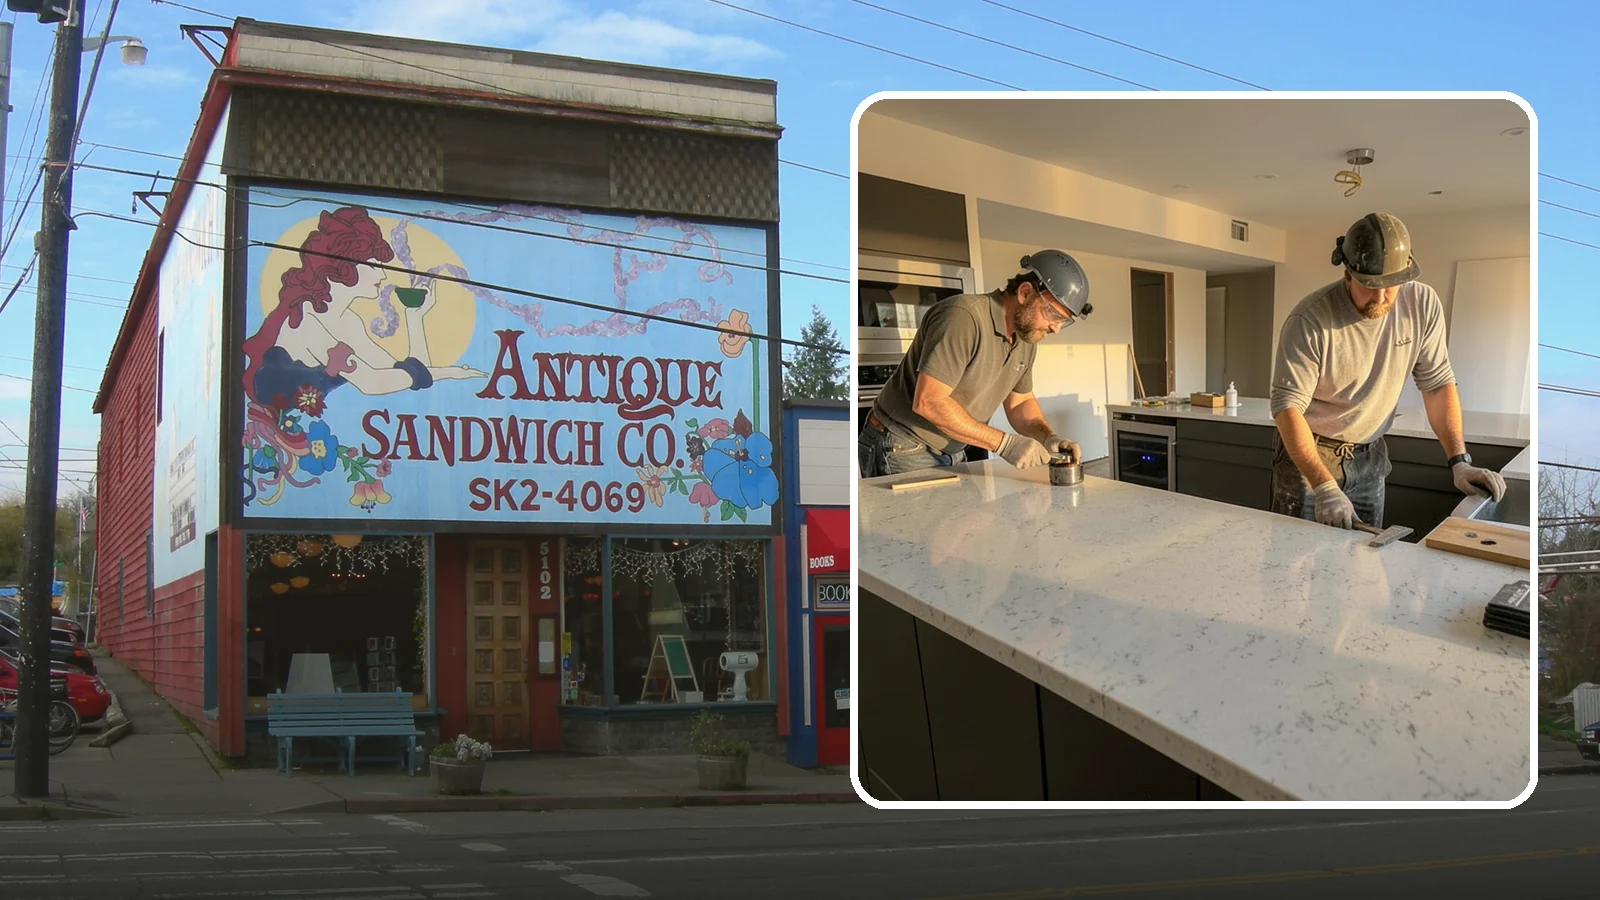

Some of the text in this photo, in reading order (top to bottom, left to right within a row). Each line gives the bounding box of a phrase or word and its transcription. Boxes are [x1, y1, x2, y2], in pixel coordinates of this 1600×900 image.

[475, 328, 724, 421] ANTIQUE
[361, 408, 685, 469] SANDWICH CO.
[468, 476, 645, 513] SK2-4069
[540, 541, 551, 600] 5102
[809, 555, 835, 569] BOOKS
